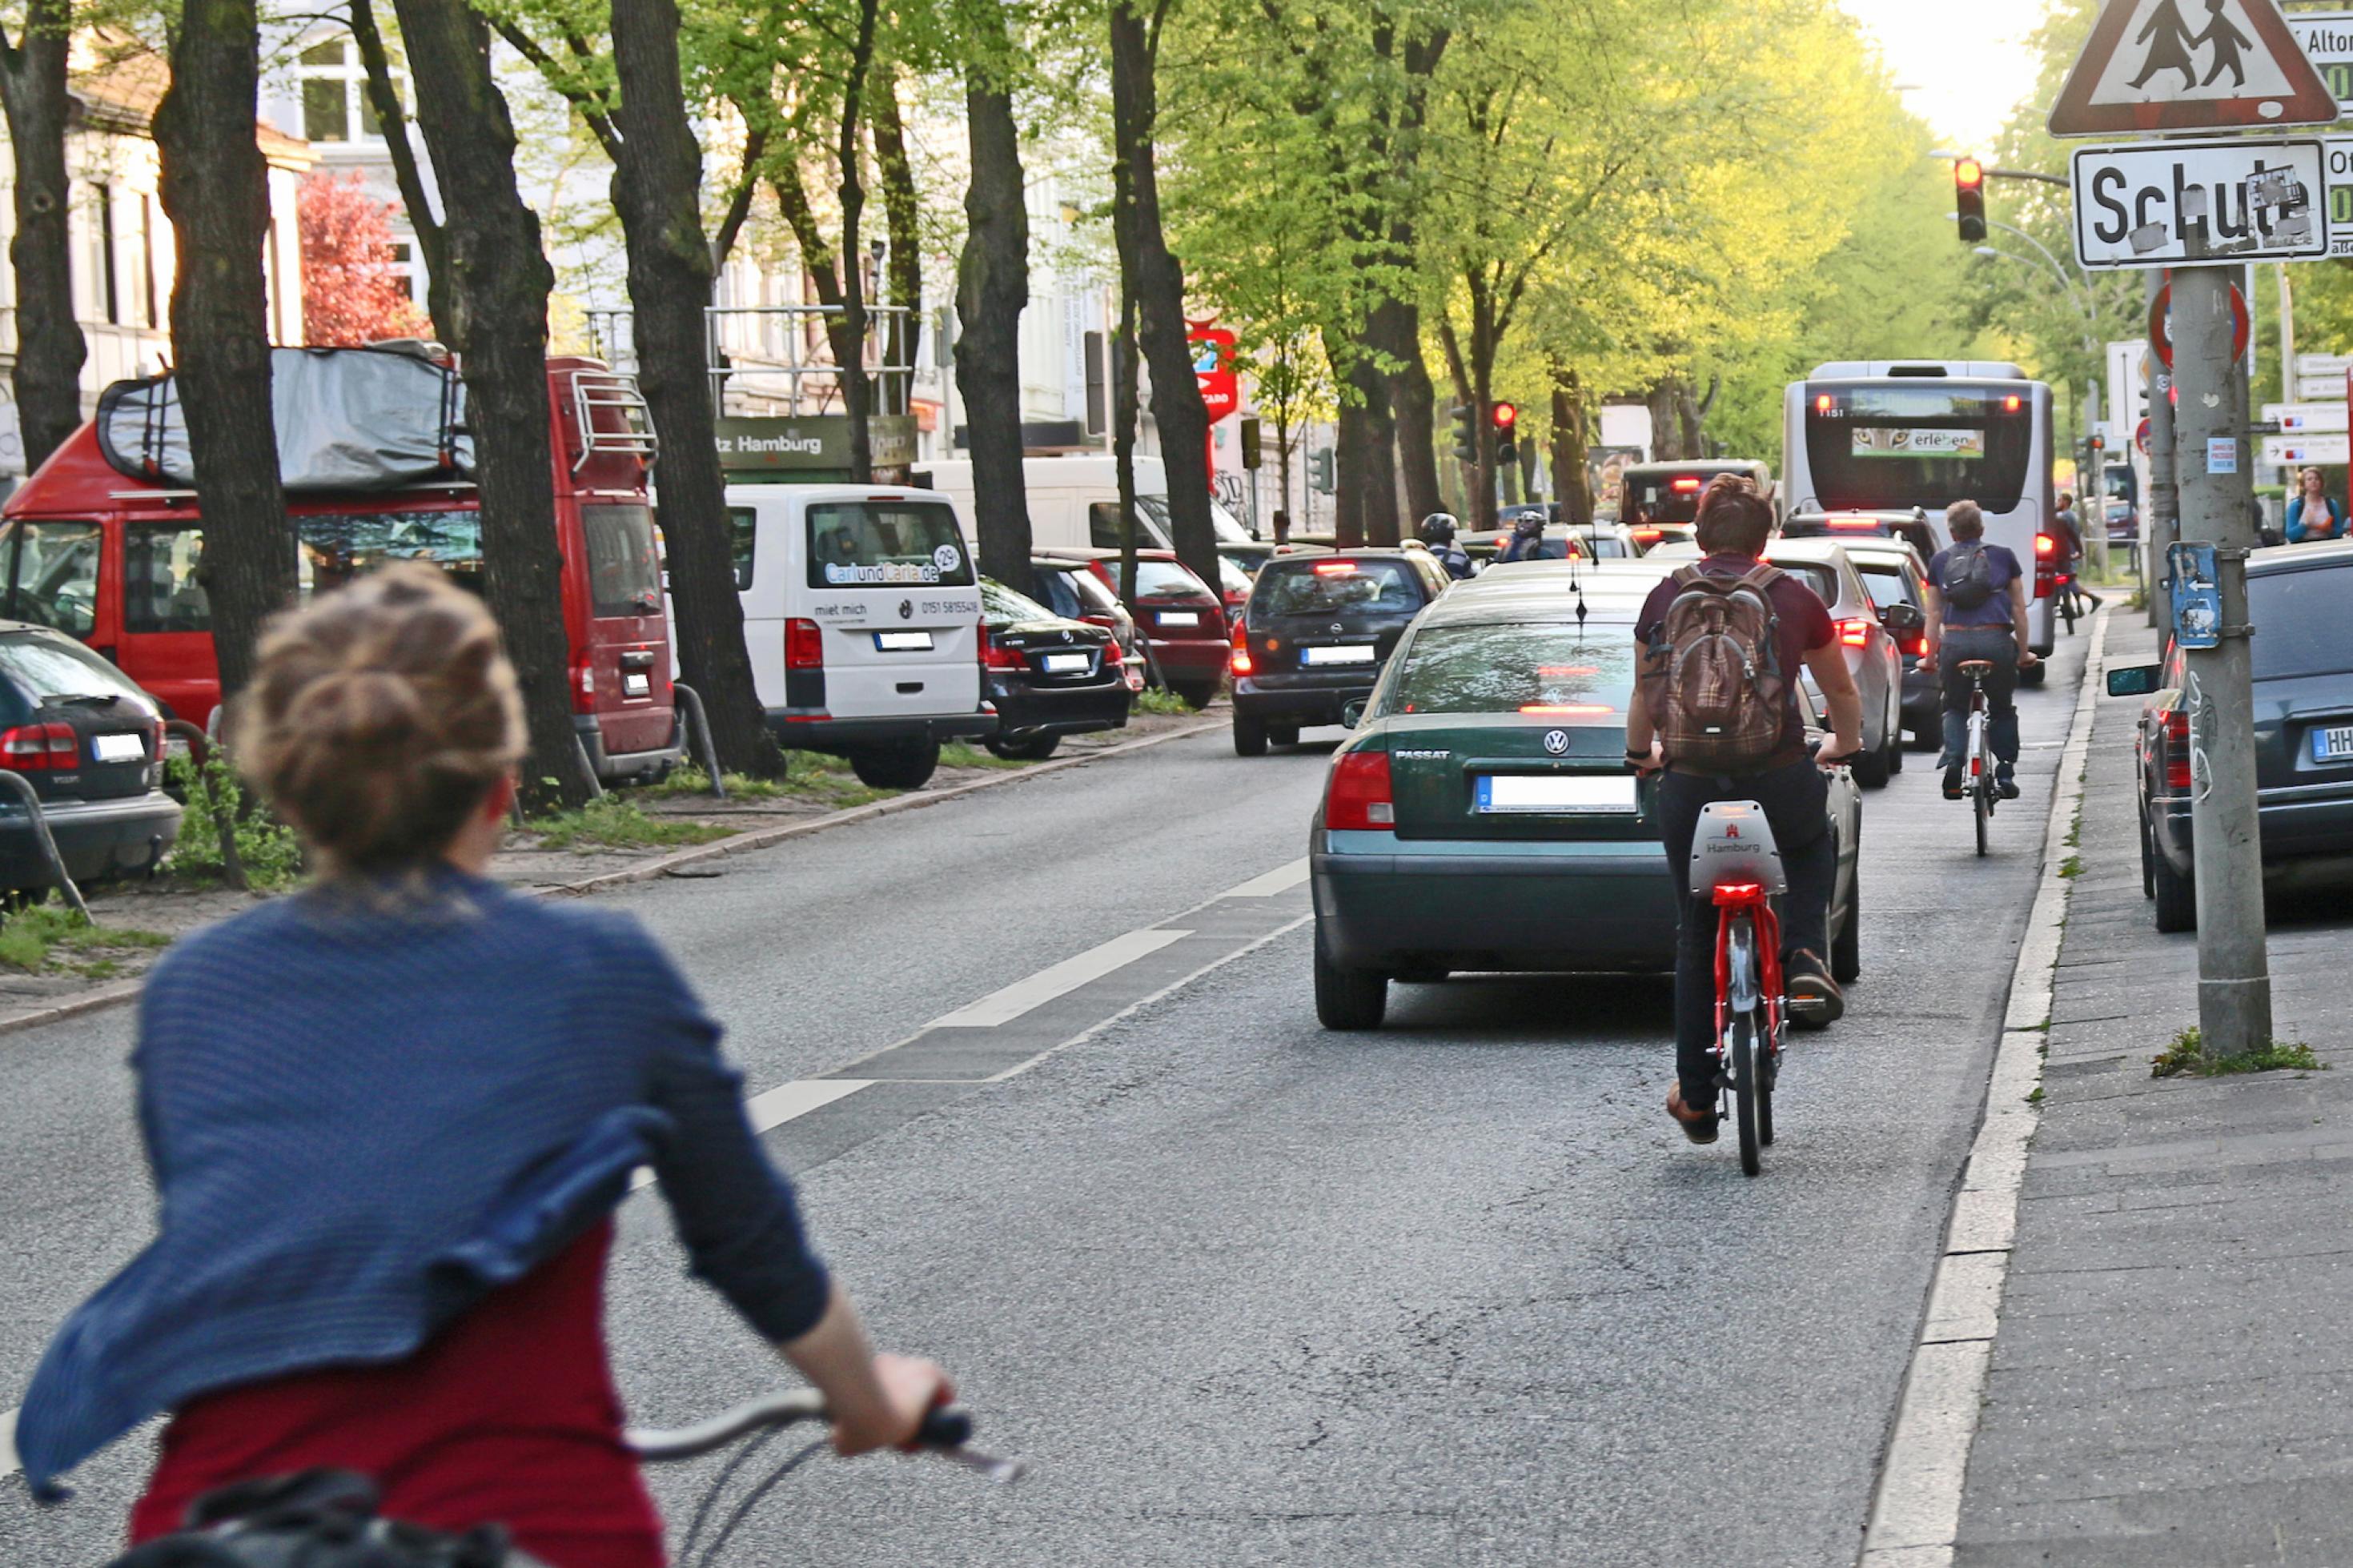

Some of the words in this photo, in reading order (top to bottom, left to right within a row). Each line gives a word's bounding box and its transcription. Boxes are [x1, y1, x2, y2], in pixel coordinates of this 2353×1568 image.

[737, 435, 822, 455] Hamburg
[828, 563, 938, 582] CarlundCarla.de
[815, 604, 838, 616] miet
[842, 602, 867, 615] mich
[1395, 751, 1450, 761] PASSAT
[1707, 843, 1761, 853] Hamburg
